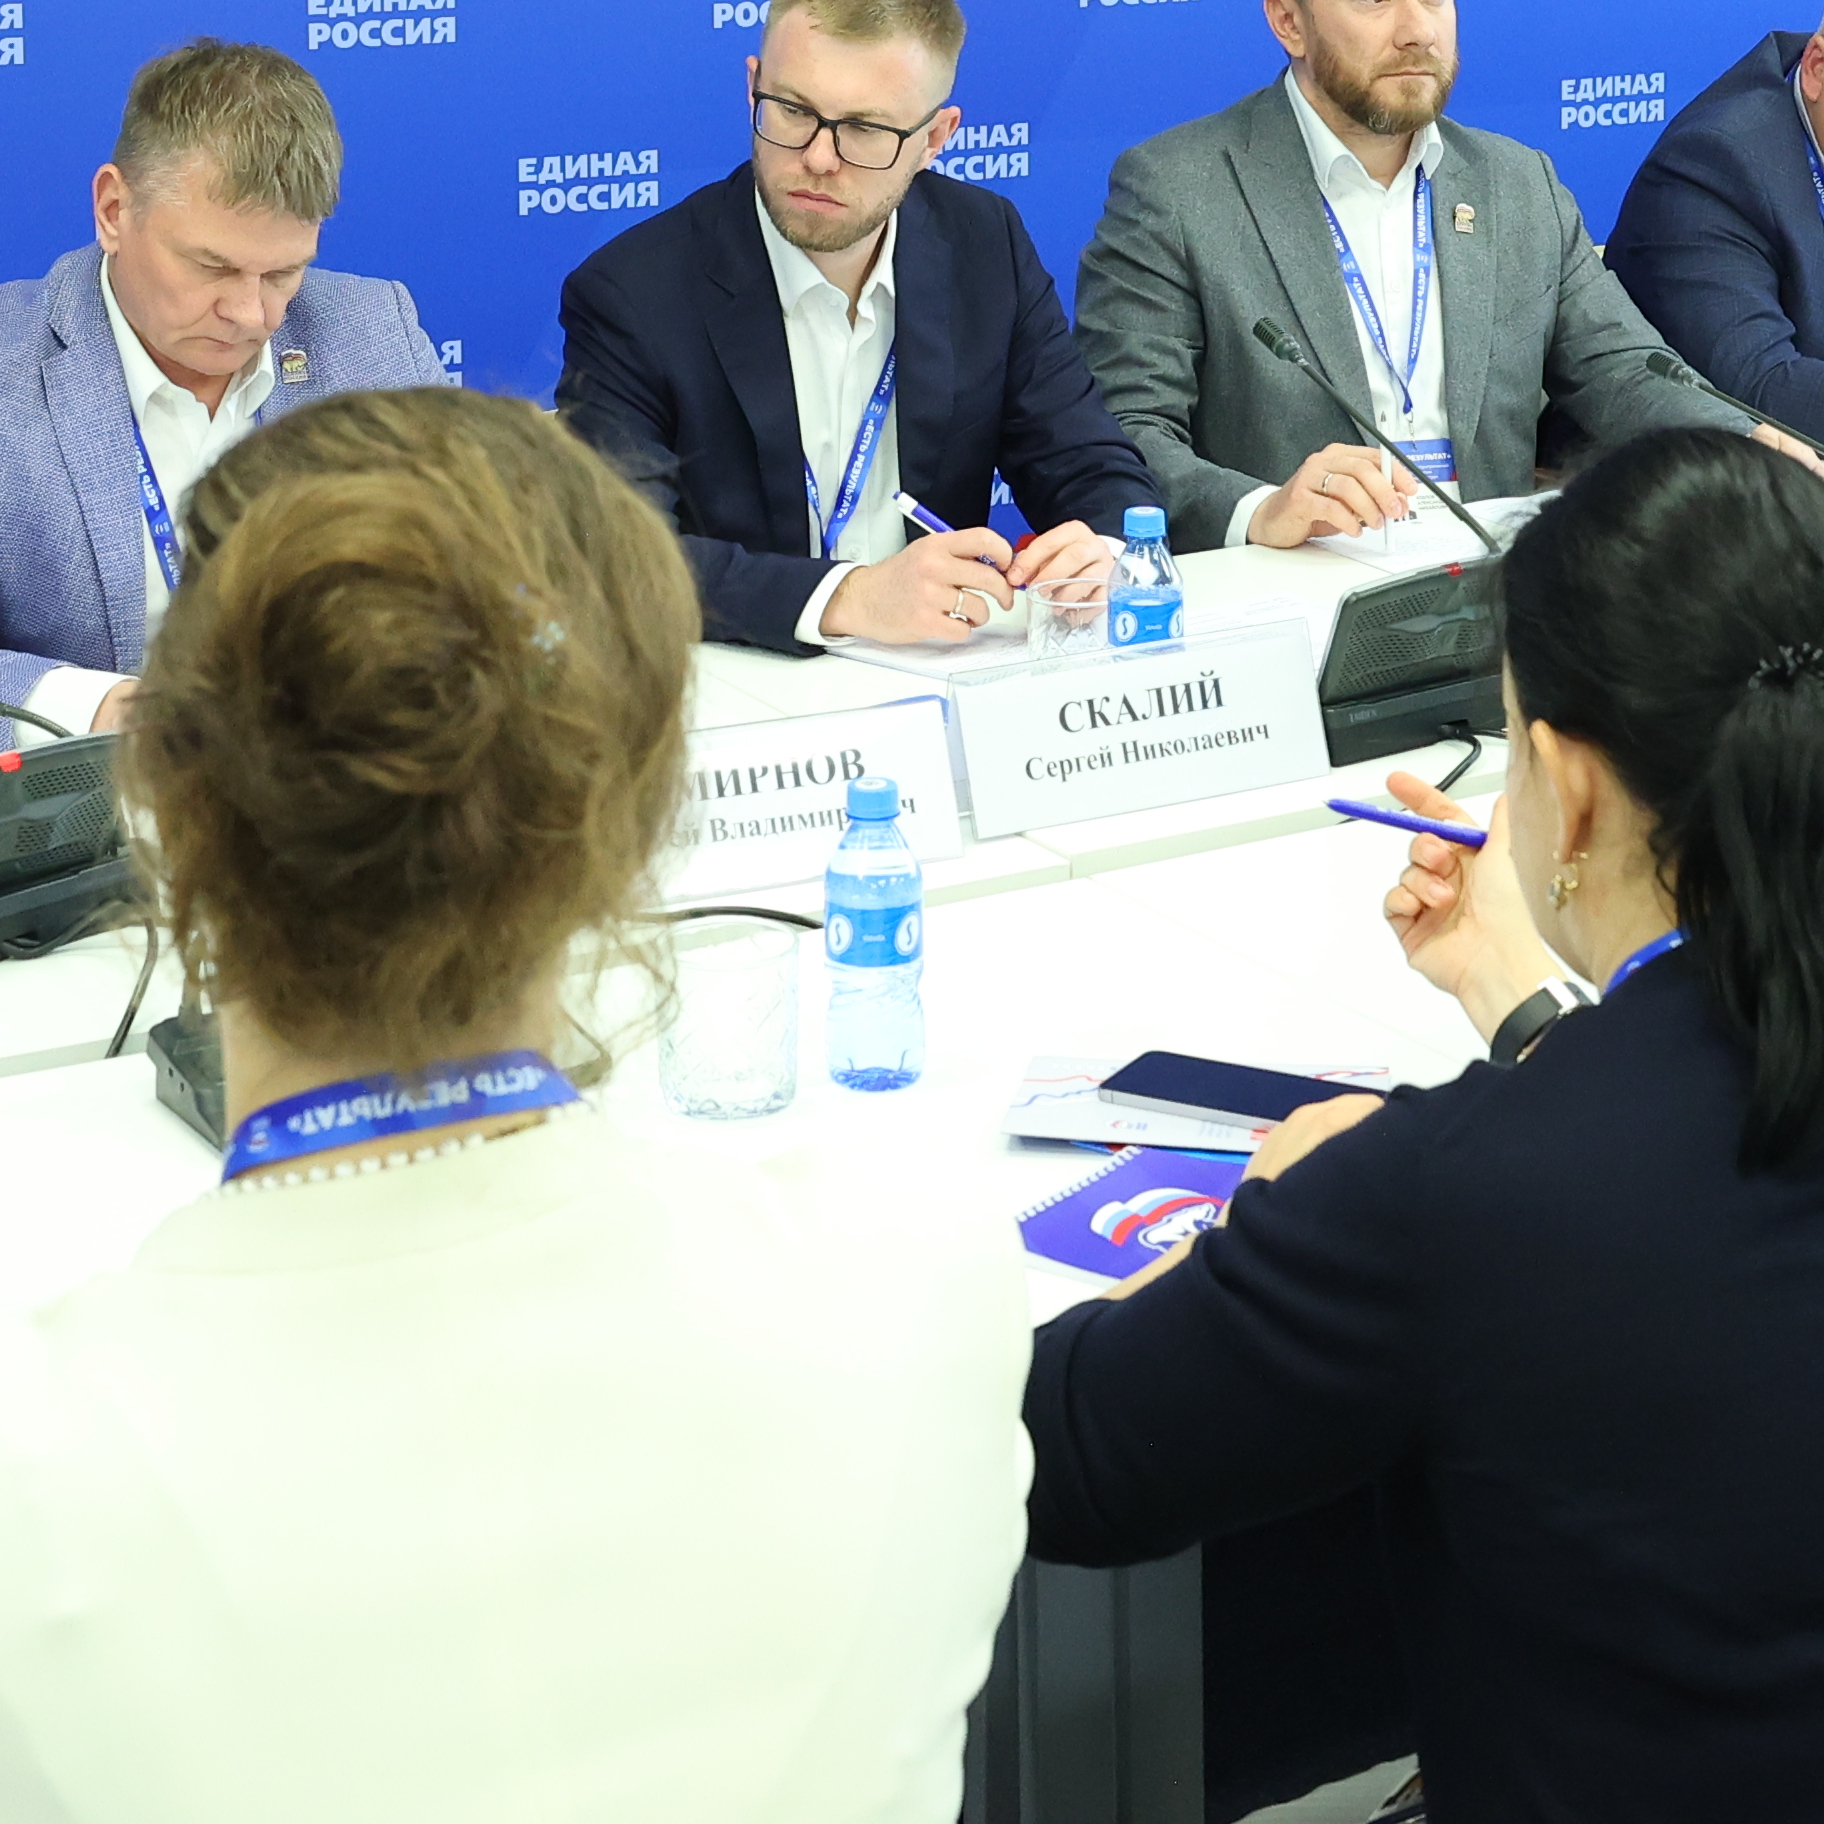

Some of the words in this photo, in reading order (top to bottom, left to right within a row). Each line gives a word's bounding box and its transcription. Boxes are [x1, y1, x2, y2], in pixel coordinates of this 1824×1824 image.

[308, 16, 456, 50] РОССИЯ
[1561, 72, 1664, 102] ЕДИНАЯ
[1561, 99, 1664, 129] РОССИЯ
[938, 122, 1029, 154] ИНАЯ
[519, 149, 658, 184] ЕДИНАЯ
[928, 152, 1029, 181] ОССИЯ
[519, 181, 659, 215] РОССИЯ
[859, 418, 875, 452] «ЕСТЬ
[837, 454, 866, 519] РЕЗУЛЬТАТ»
[1058, 670, 1227, 733] СКАЛИЙ
[1025, 744, 1114, 783] Сергей
[1121, 724, 1270, 765] Николаевич
[686, 748, 865, 802] МИРНОВ
[709, 797, 916, 843] Владимирч
